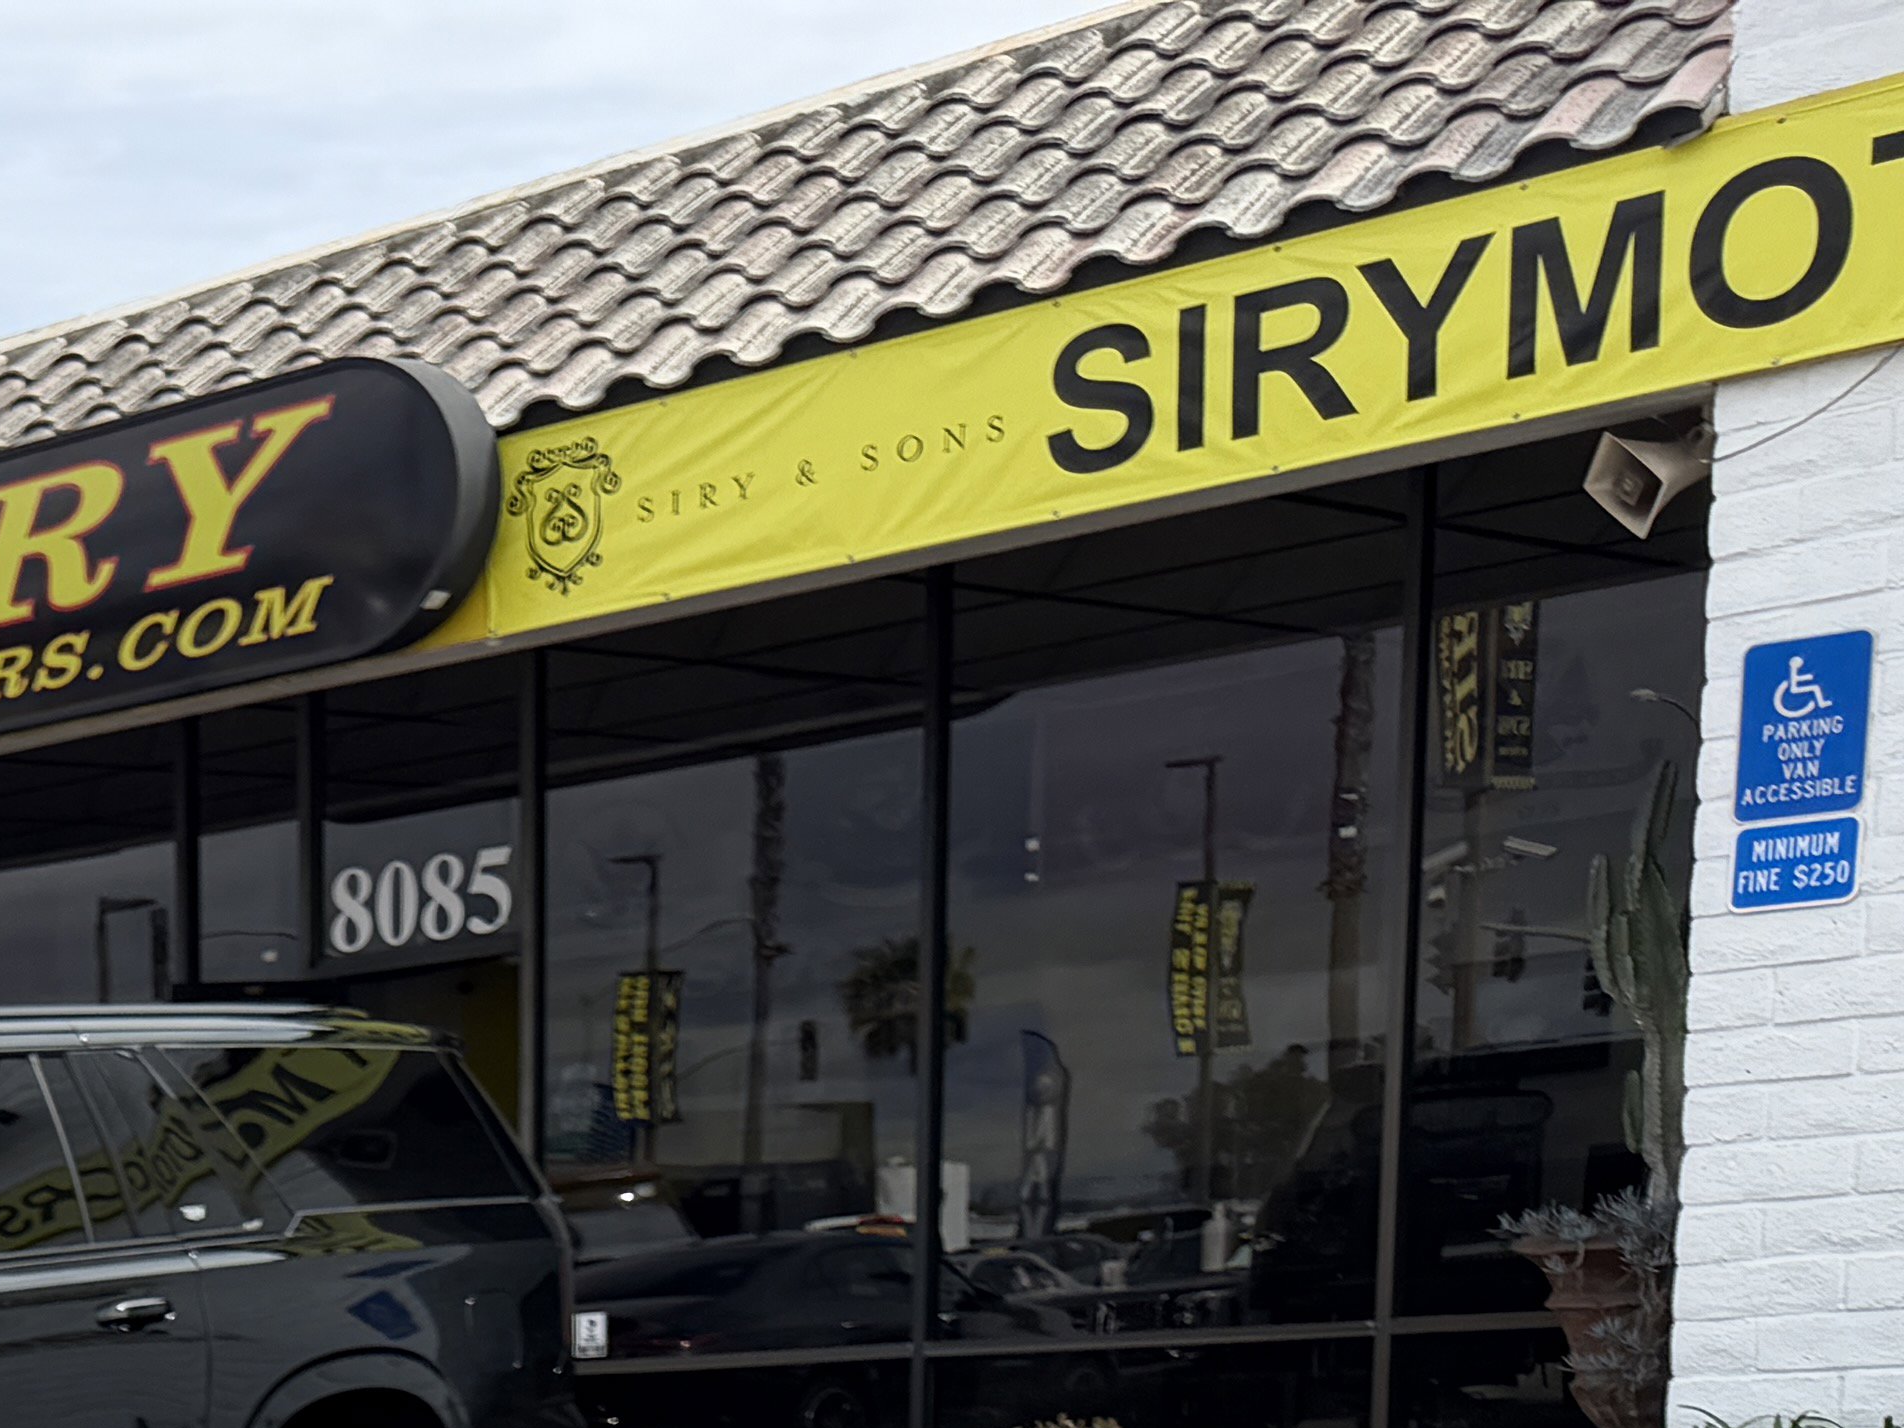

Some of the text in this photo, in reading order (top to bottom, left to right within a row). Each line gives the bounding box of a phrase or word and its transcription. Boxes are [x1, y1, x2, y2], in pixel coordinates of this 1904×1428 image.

[1047, 130, 1904, 474] SIRYMO
[638, 414, 1006, 523] SIRY & SONS
[1762, 715, 1844, 743] PARKING
[1777, 739, 1825, 761] ONLY
[1782, 760, 1820, 780] VAN
[1740, 775, 1858, 807] ACCESSIBLE
[1752, 832, 1840, 862] MINIMUM
[1737, 860, 1850, 893] FINE $250
[330, 846, 512, 954] 8085
